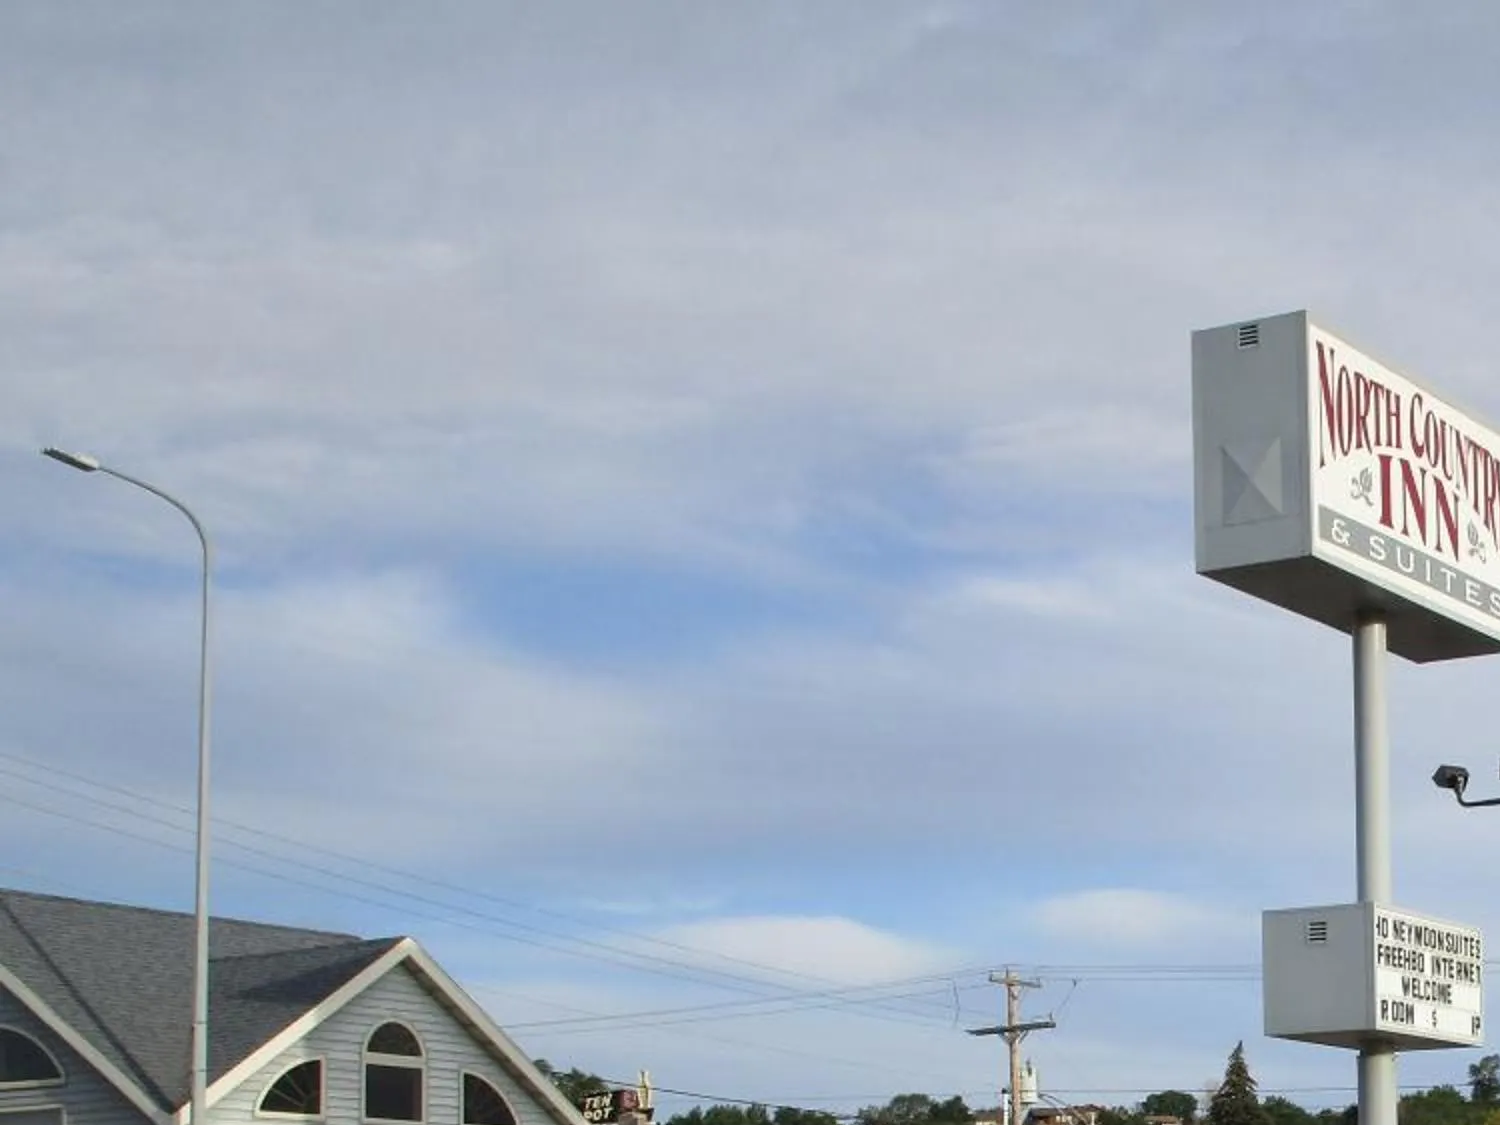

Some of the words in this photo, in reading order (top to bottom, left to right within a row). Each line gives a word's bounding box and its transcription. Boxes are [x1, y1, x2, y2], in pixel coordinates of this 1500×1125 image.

[1316, 341, 1402, 468] NORTH
[1378, 454, 1459, 562] INN
[1331, 519, 1351, 546] &
[1431, 955, 1481, 984] INTERNET
[1402, 976, 1452, 1004] WELCOME
[1381, 999, 1415, 1024] ROOM
